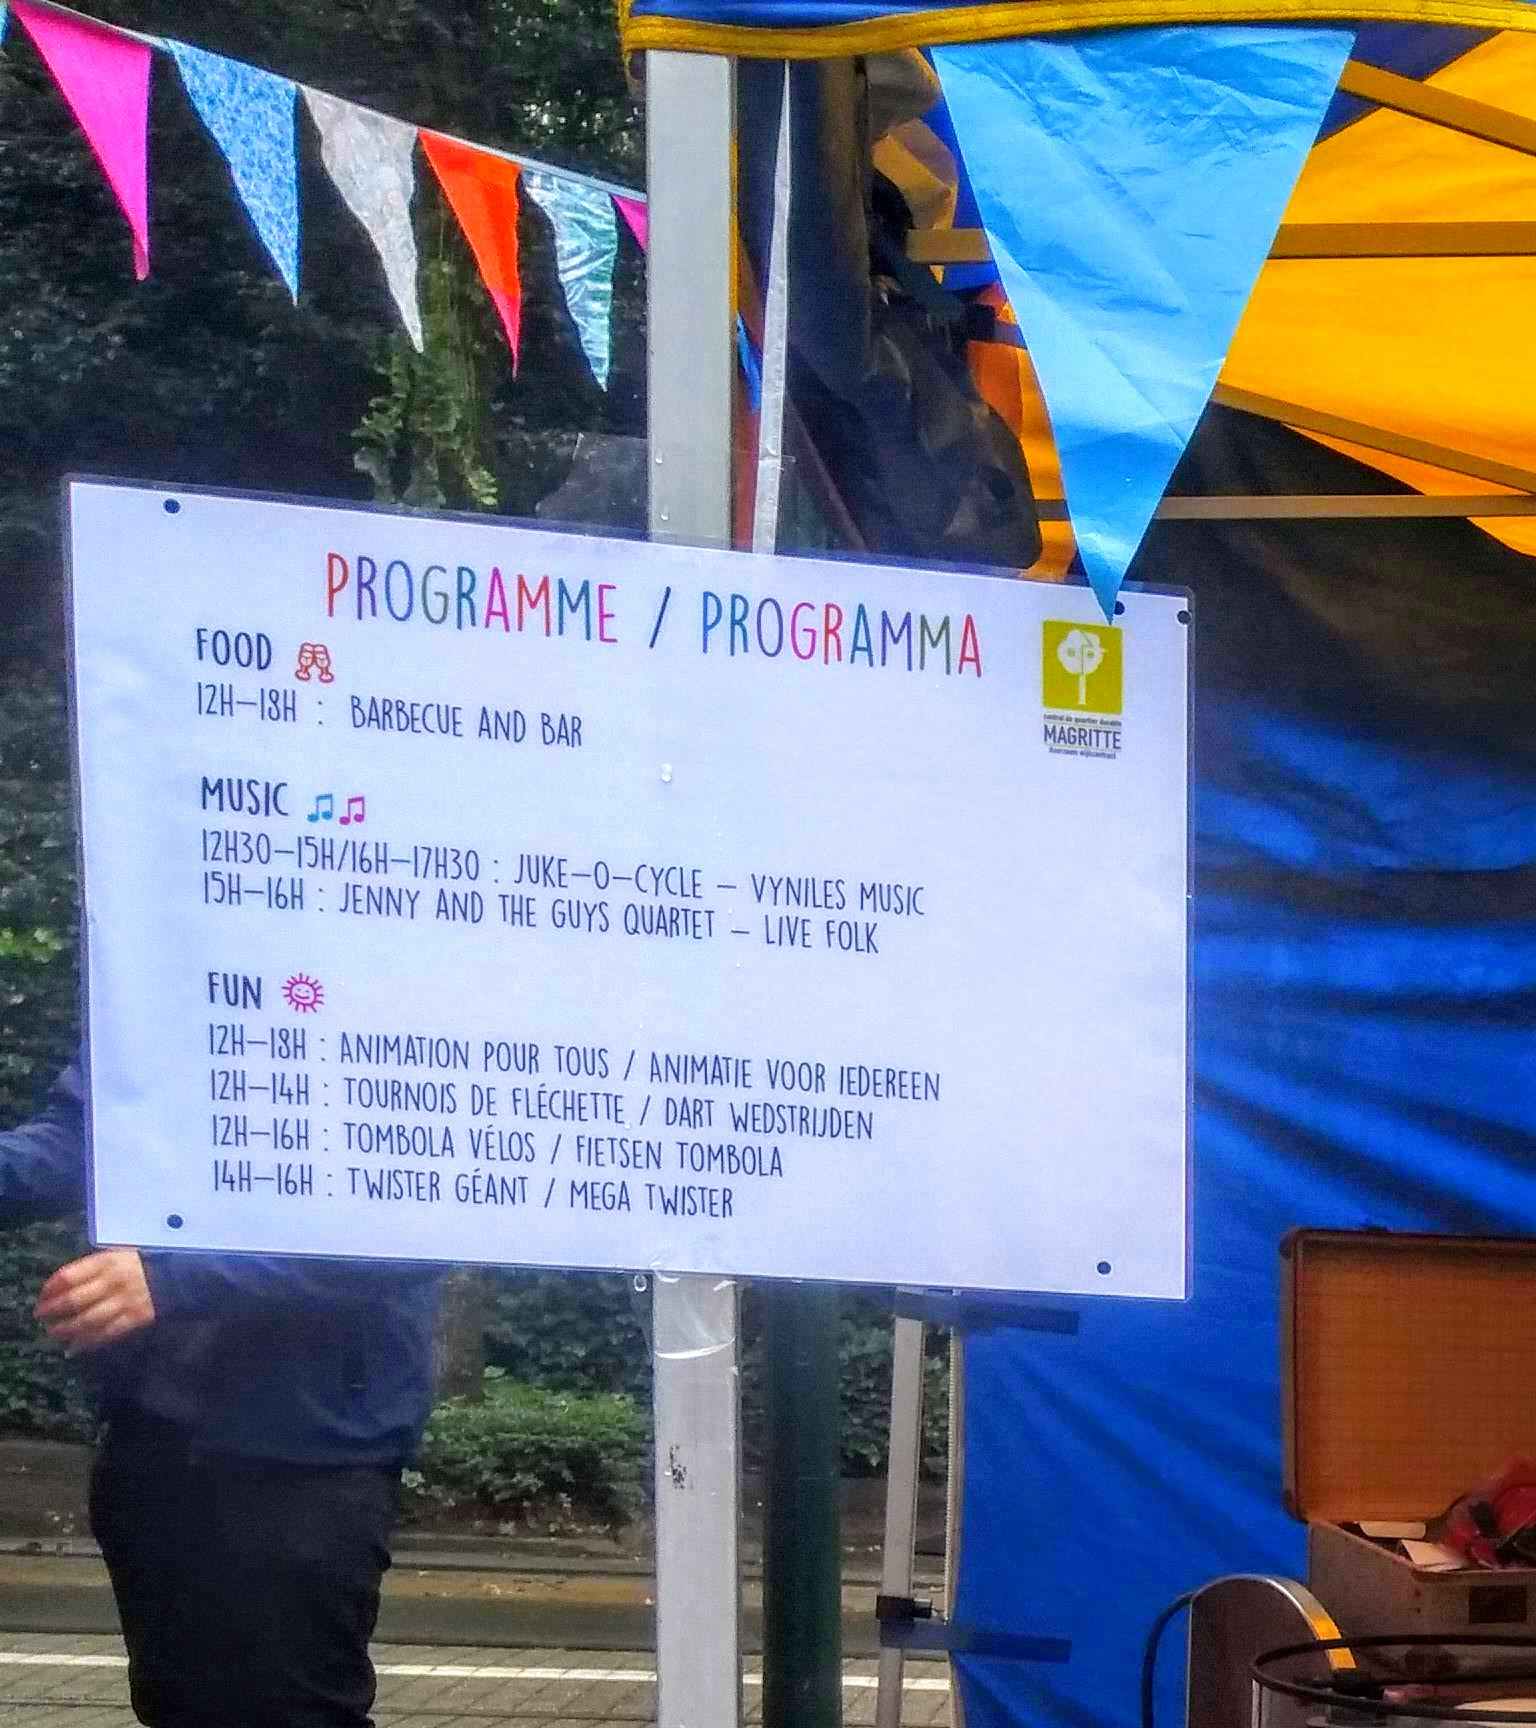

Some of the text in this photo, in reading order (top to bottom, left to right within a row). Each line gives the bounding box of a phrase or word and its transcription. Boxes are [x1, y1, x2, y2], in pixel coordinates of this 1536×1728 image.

[327, 552, 618, 644] PROGRAMME
[702, 590, 982, 678] PROGRAMMA
[196, 627, 273, 672] FOOD
[350, 694, 464, 738] BARBECUE
[477, 705, 527, 744] AND
[540, 712, 583, 749] BAR
[1043, 723, 1122, 750] MAGRITTE
[200, 775, 289, 818] MUSIC
[338, 881, 421, 920] JENNY
[435, 887, 484, 925] AND
[497, 893, 537, 928] THE
[551, 898, 610, 933] GUYS
[623, 903, 715, 940] QUARTET
[764, 914, 813, 949] LIVE
[825, 919, 880, 954] FOLK
[750, 873, 846, 911] VYNILES
[859, 881, 926, 917] MUSIC
[207, 971, 262, 1010] FUN
[340, 1031, 470, 1070] ANIMATION
[483, 1040, 540, 1076] POUR
[553, 1044, 610, 1079] TOUS
[649, 1051, 753, 1089] ANIMATIE
[765, 1058, 826, 1094] VOOR
[839, 1064, 941, 1102] IEDEREEN
[343, 1076, 458, 1114] TOURNOIS
[470, 1083, 498, 1117] DE
[511, 1082, 625, 1125] FLÉCHETTE
[665, 1095, 715, 1130] DART
[729, 1101, 874, 1140] WEDSTRIJDEN
[343, 1121, 455, 1159] TOMBOLA
[468, 1123, 536, 1163] VÉLOS
[576, 1134, 662, 1170] FIETSEN
[675, 1141, 784, 1178] TOMBOLA
[347, 1167, 441, 1203] TWISTER
[454, 1167, 529, 1206] GÉANT
[570, 1179, 632, 1213] MEGA
[644, 1183, 733, 1219] TWISTER
